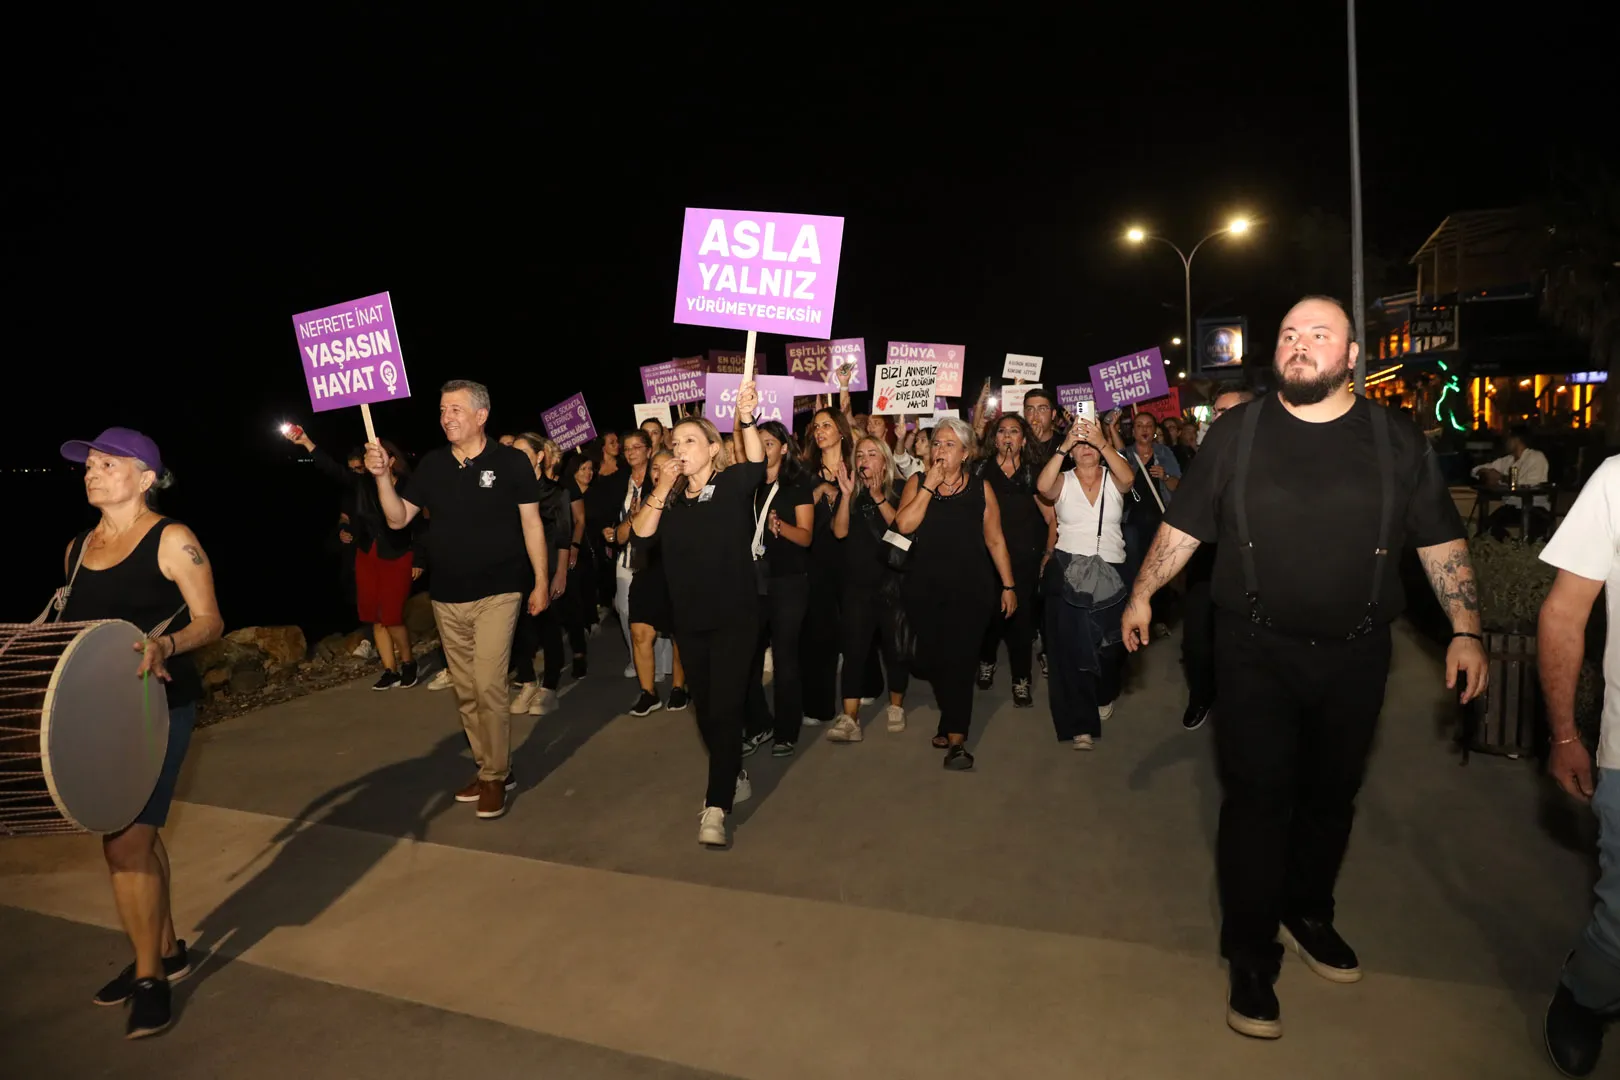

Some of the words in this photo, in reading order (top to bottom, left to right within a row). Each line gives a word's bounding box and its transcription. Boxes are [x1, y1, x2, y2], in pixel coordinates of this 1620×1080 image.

[698, 218, 821, 264] ASLA
[698, 262, 817, 300] YALNIZ
[686, 297, 821, 324] YÜRÜMEYECEKSİN
[299, 312, 355, 340] NEFRETE
[355, 304, 384, 327] İNAT
[305, 328, 392, 370] YAŞASIN
[789, 345, 827, 358] EŞİTLİK
[828, 343, 861, 354] YOKSA
[889, 344, 936, 358] DÜNYA
[717, 356, 729, 364] EN
[791, 356, 829, 376] AŞK
[1099, 355, 1151, 379] EŞİTLİK
[646, 375, 678, 387] İNADINA
[679, 370, 702, 380] İSYAN
[881, 366, 902, 380] BİZİ
[905, 364, 937, 378] ANNEMİZ
[312, 365, 375, 399] HAYAT
[654, 380, 698, 395] İNADINA
[1104, 369, 1152, 392] HEMEN
[650, 388, 706, 404] ÖZGÜRLÜK
[720, 388, 777, 404] 624'Ü
[1060, 386, 1093, 396] PATRİYA
[1111, 381, 1151, 405] ŞİMDİ
[559, 398, 581, 414] SOKAKTA
[715, 404, 782, 420] UYULA
[552, 411, 573, 426] YERİNDE
[550, 424, 568, 437] ERKEK
[559, 440, 572, 450] ARŞI
